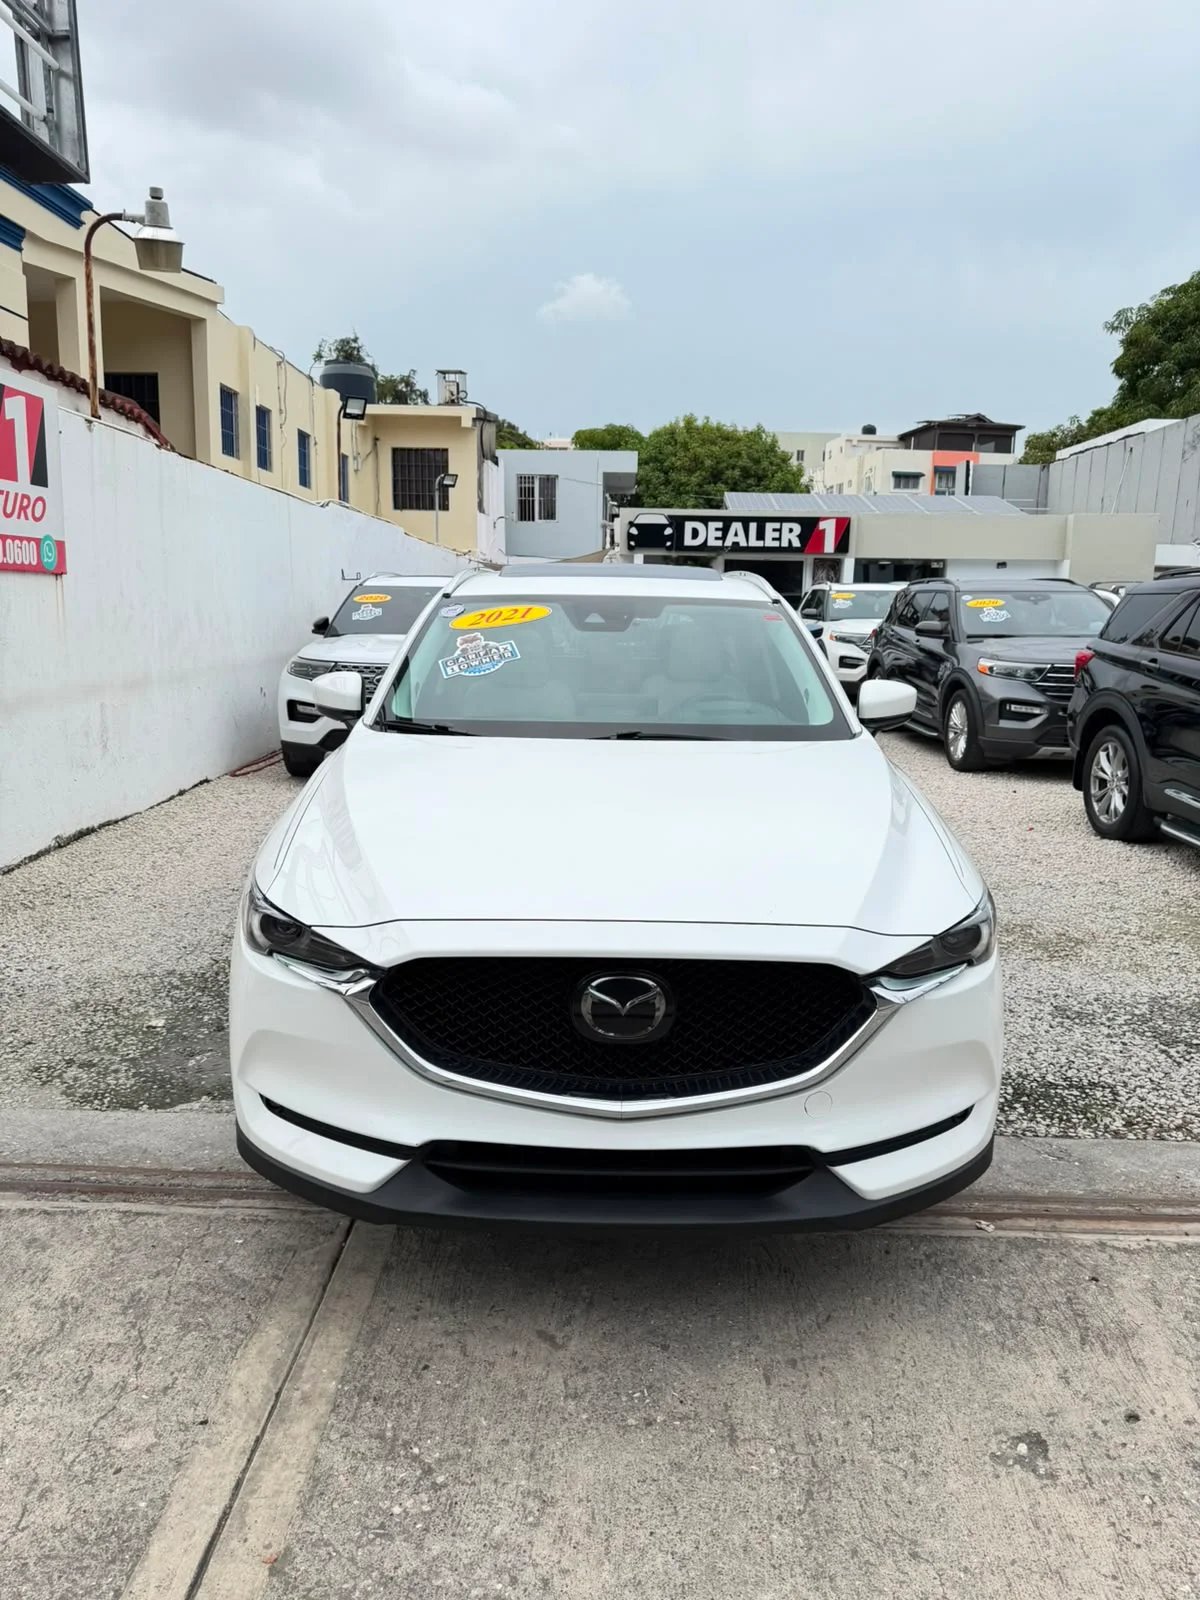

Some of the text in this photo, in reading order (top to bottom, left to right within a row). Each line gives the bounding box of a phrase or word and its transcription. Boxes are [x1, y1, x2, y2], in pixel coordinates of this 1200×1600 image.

[4, 395, 31, 483] 1
[683, 518, 837, 553] DEALER 1
[467, 607, 534, 627] 2021
[446, 646, 510, 667] CARFAX
